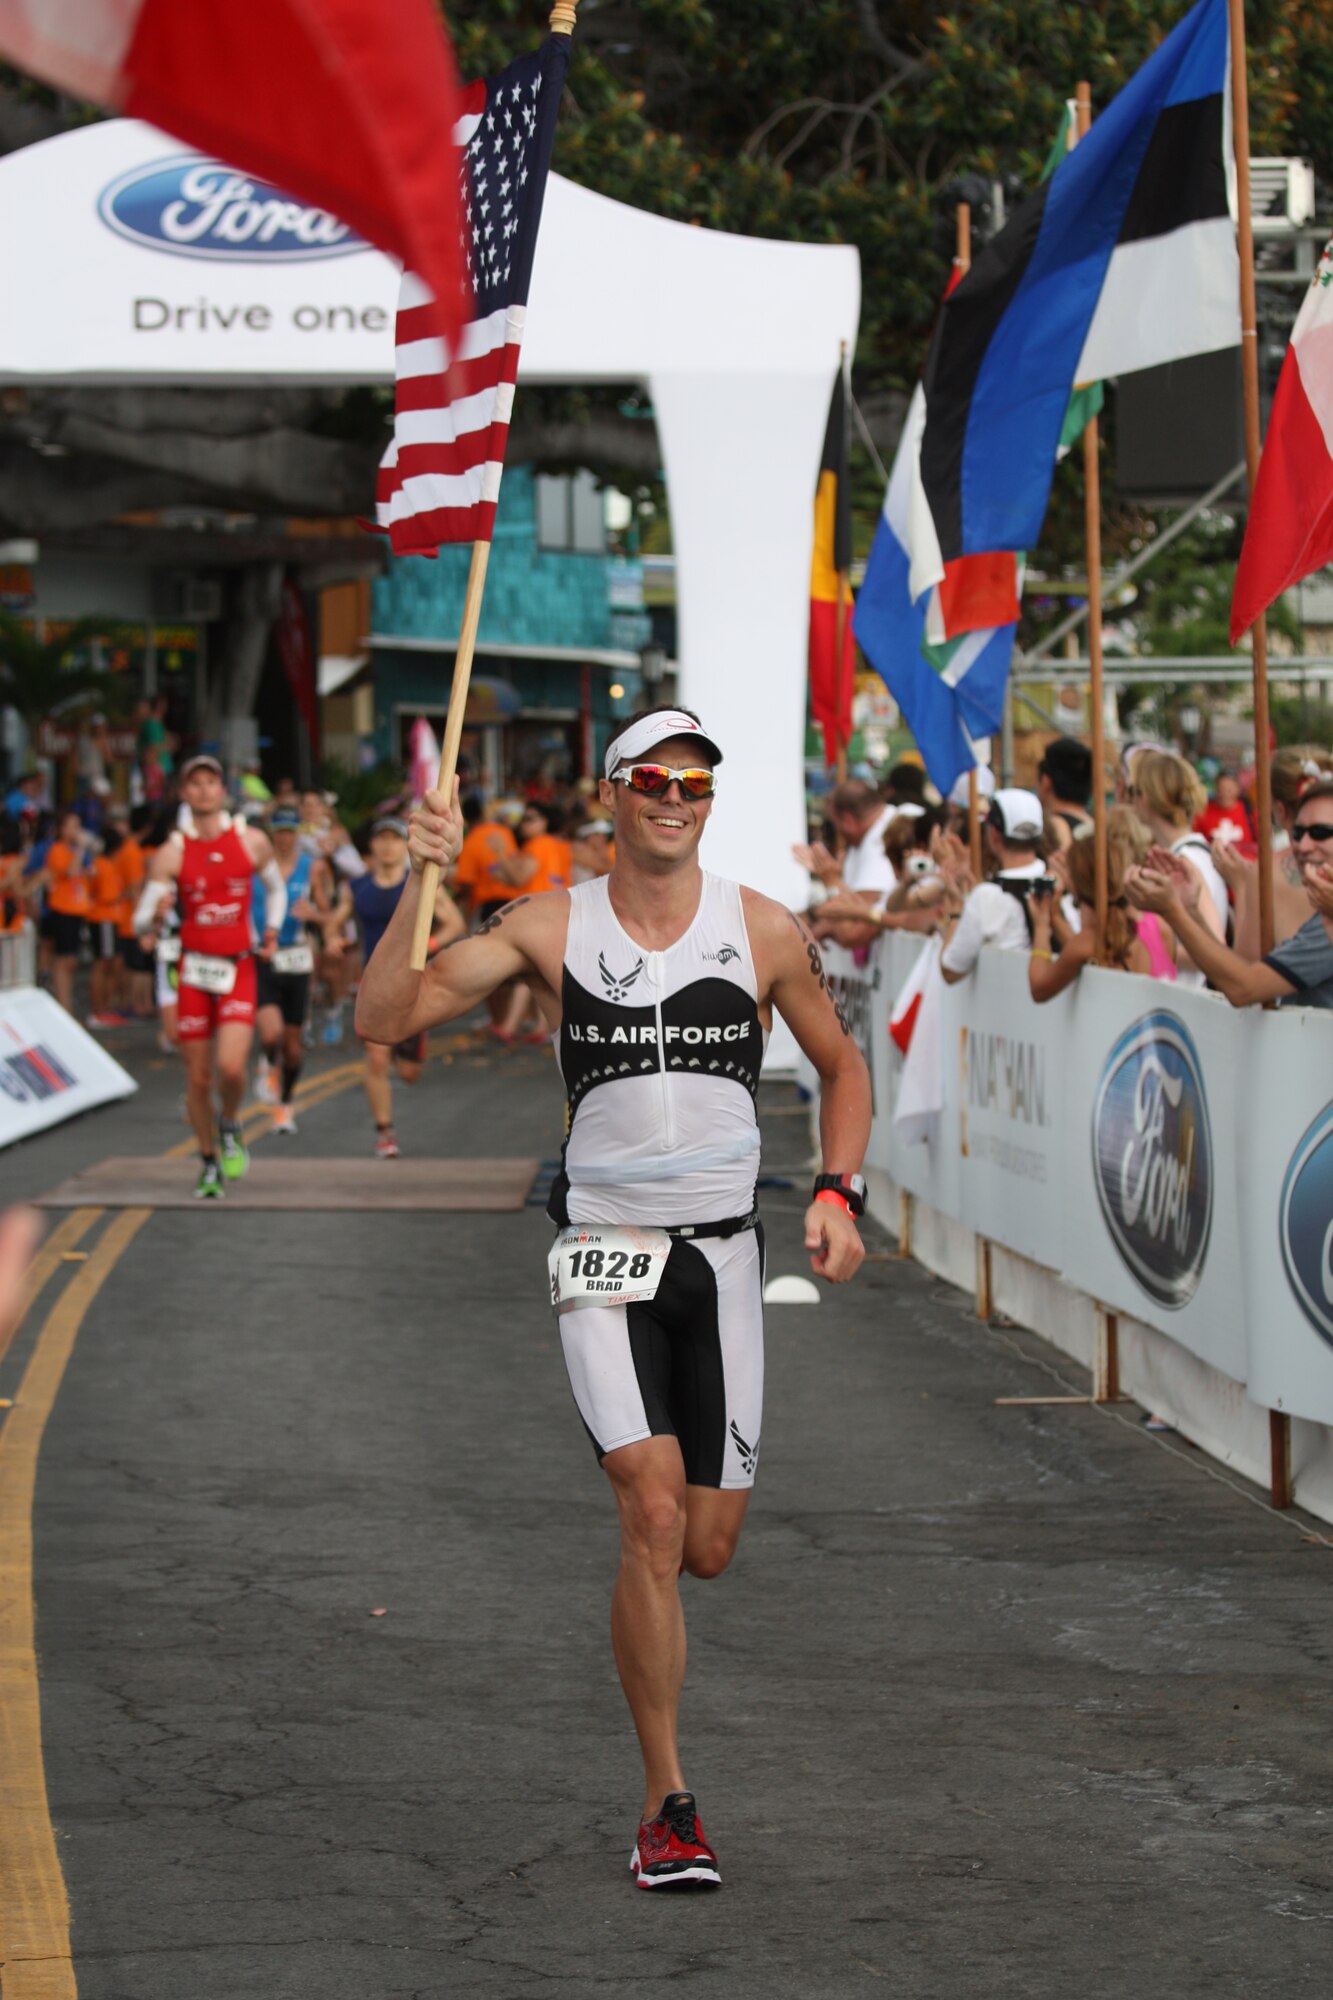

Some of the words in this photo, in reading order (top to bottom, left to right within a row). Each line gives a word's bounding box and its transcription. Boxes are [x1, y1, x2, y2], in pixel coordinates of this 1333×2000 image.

[132, 296, 272, 332] Drive
[569, 1023, 606, 1044] U.S.
[610, 1026, 657, 1044] AIR
[665, 1020, 751, 1044] FORCE
[1120, 1055, 1195, 1258] Ford
[561, 1232, 602, 1246] IRONMAN
[569, 1249, 652, 1279] 1828
[586, 1280, 623, 1292] BRAD
[607, 1294, 641, 1305] TIMEX
